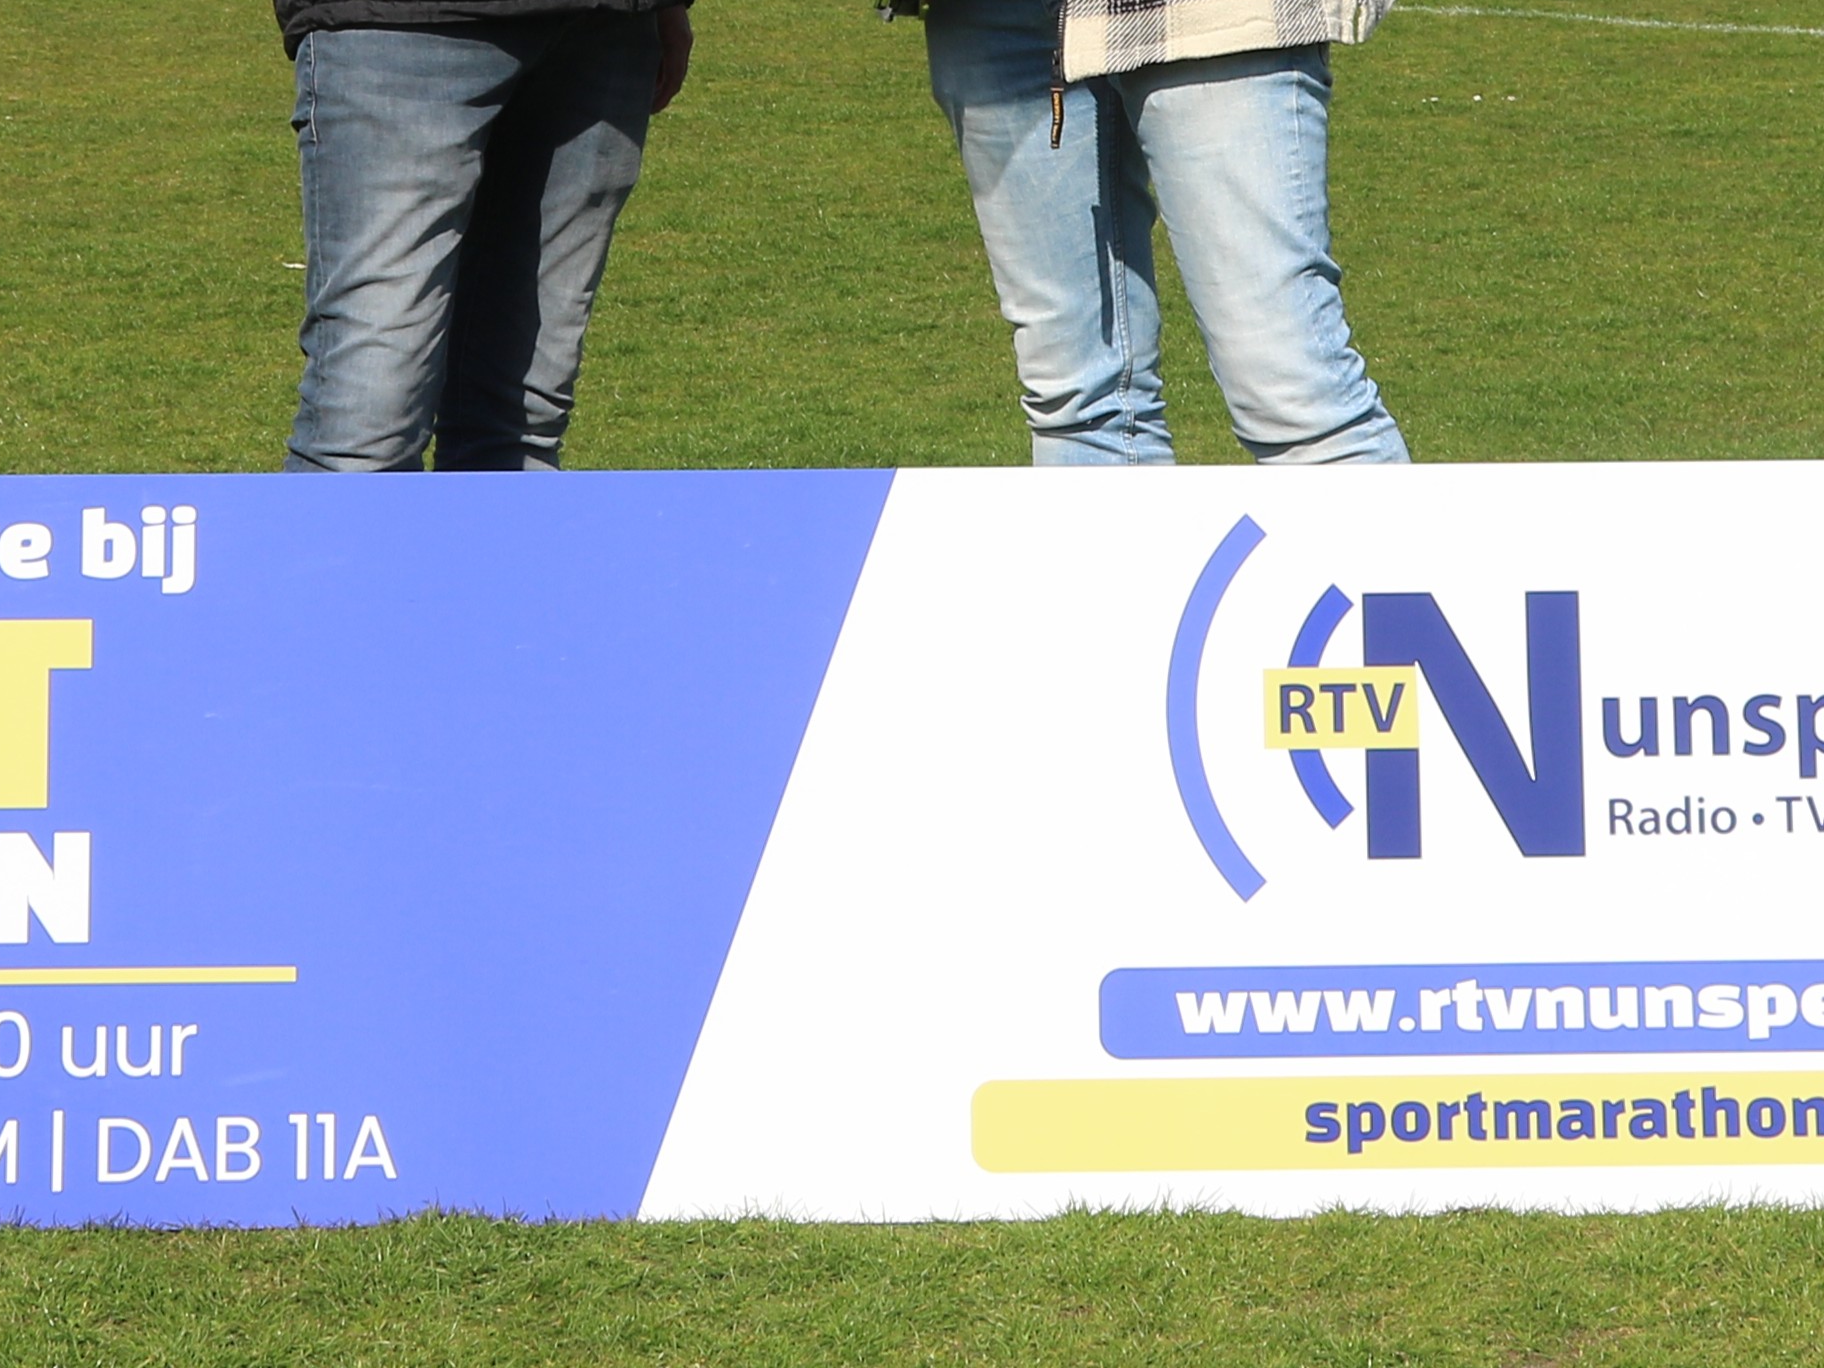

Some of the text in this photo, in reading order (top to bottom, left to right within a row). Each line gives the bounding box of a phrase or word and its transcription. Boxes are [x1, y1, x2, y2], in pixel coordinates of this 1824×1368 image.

[81, 504, 197, 594] bij
[1279, 682, 1406, 734] RTV
[1609, 794, 1737, 835] Radio
[61, 1024, 198, 1078] uur
[97, 1116, 261, 1183] DAB
[288, 1112, 398, 1180] 11A
